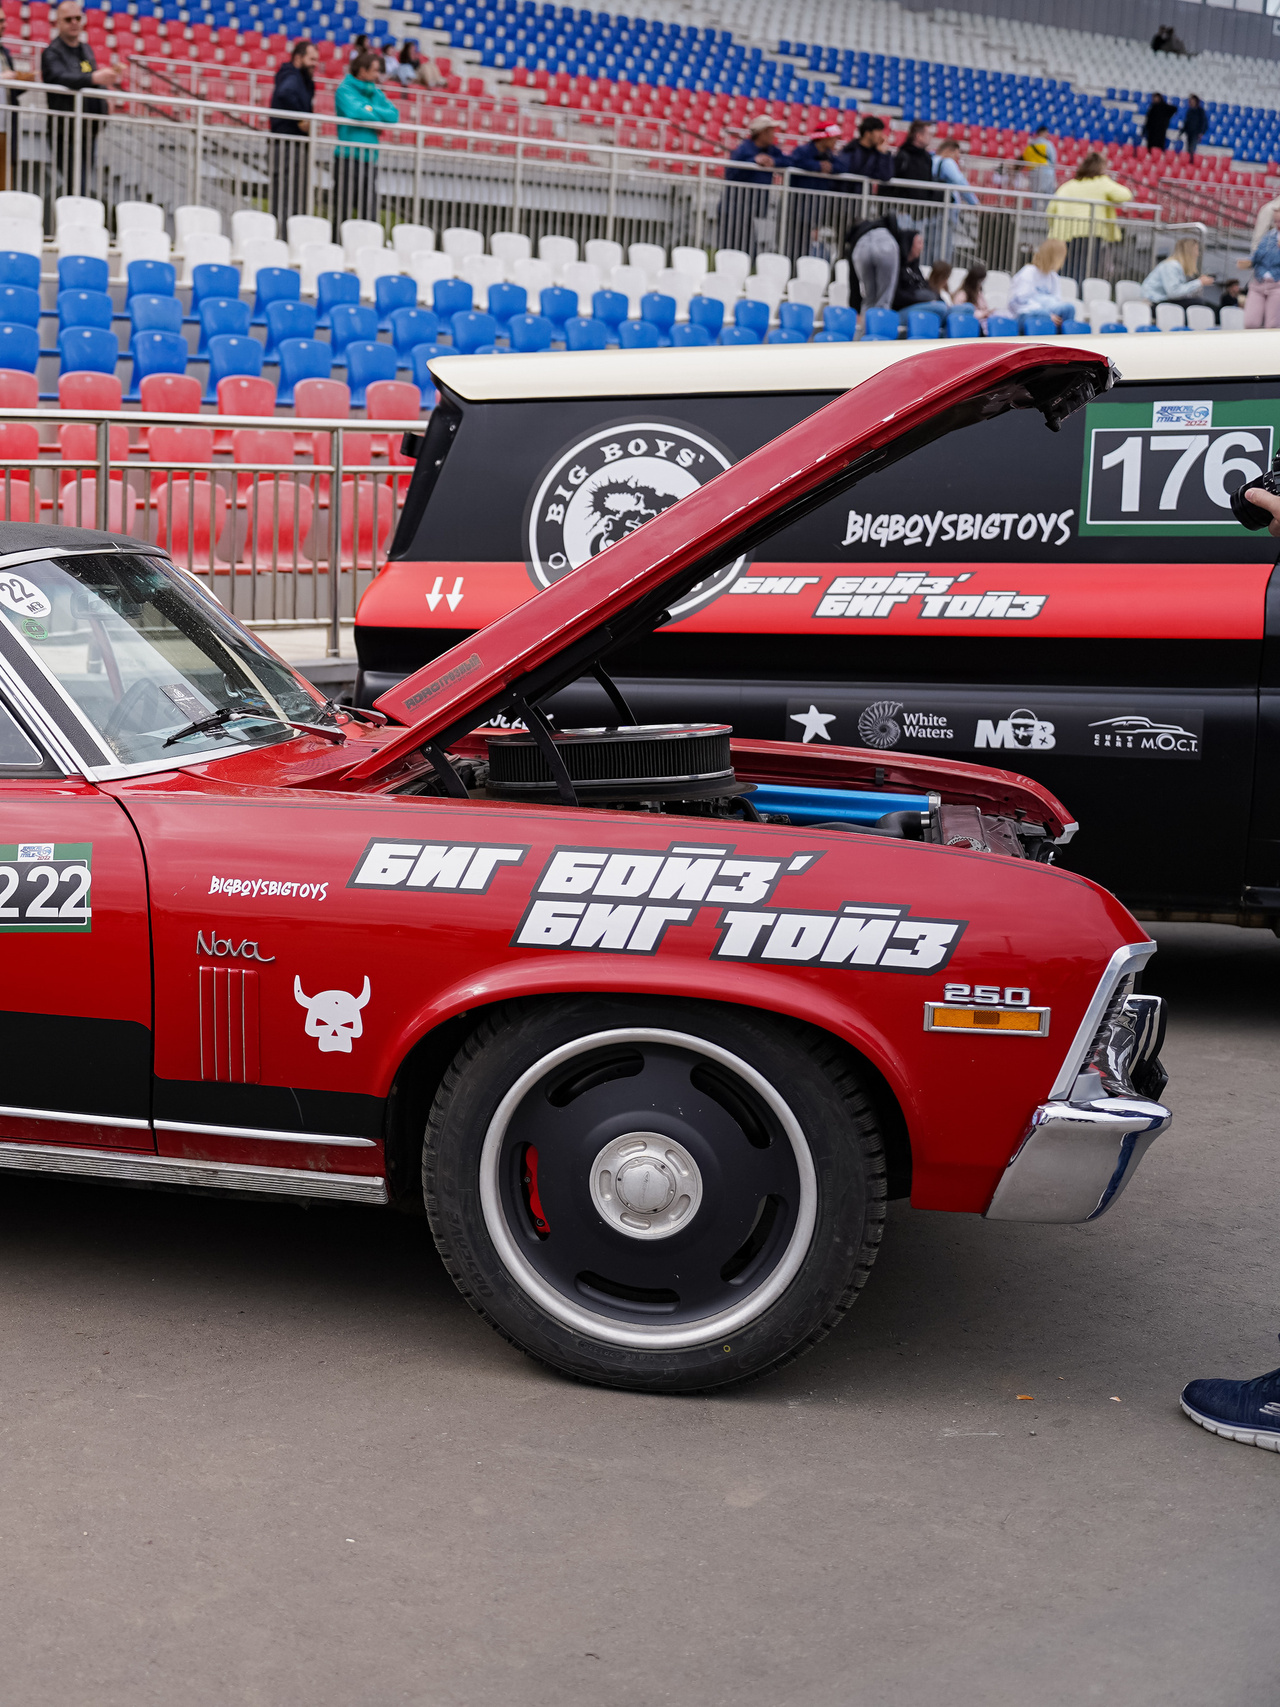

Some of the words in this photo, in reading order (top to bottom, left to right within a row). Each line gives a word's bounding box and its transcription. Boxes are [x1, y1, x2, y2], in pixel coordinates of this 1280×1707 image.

[1101, 430, 1265, 513] 176
[545, 463, 590, 525] BIG
[841, 508, 1075, 548] BIGBOYSBIGTOYS
[728, 576, 821, 594] БИГ
[814, 594, 910, 617] БИГ
[920, 590, 1048, 618] ТОЙЗ
[903, 712, 948, 727] White
[903, 725, 955, 739] Waters
[353, 842, 524, 891] БИГ
[208, 875, 329, 901] BIGBOYSBIGTOYS
[195, 929, 276, 962] Nova
[516, 899, 693, 951] БИГ
[716, 905, 960, 969] ТОЙЗ
[944, 983, 1031, 1006] 250
